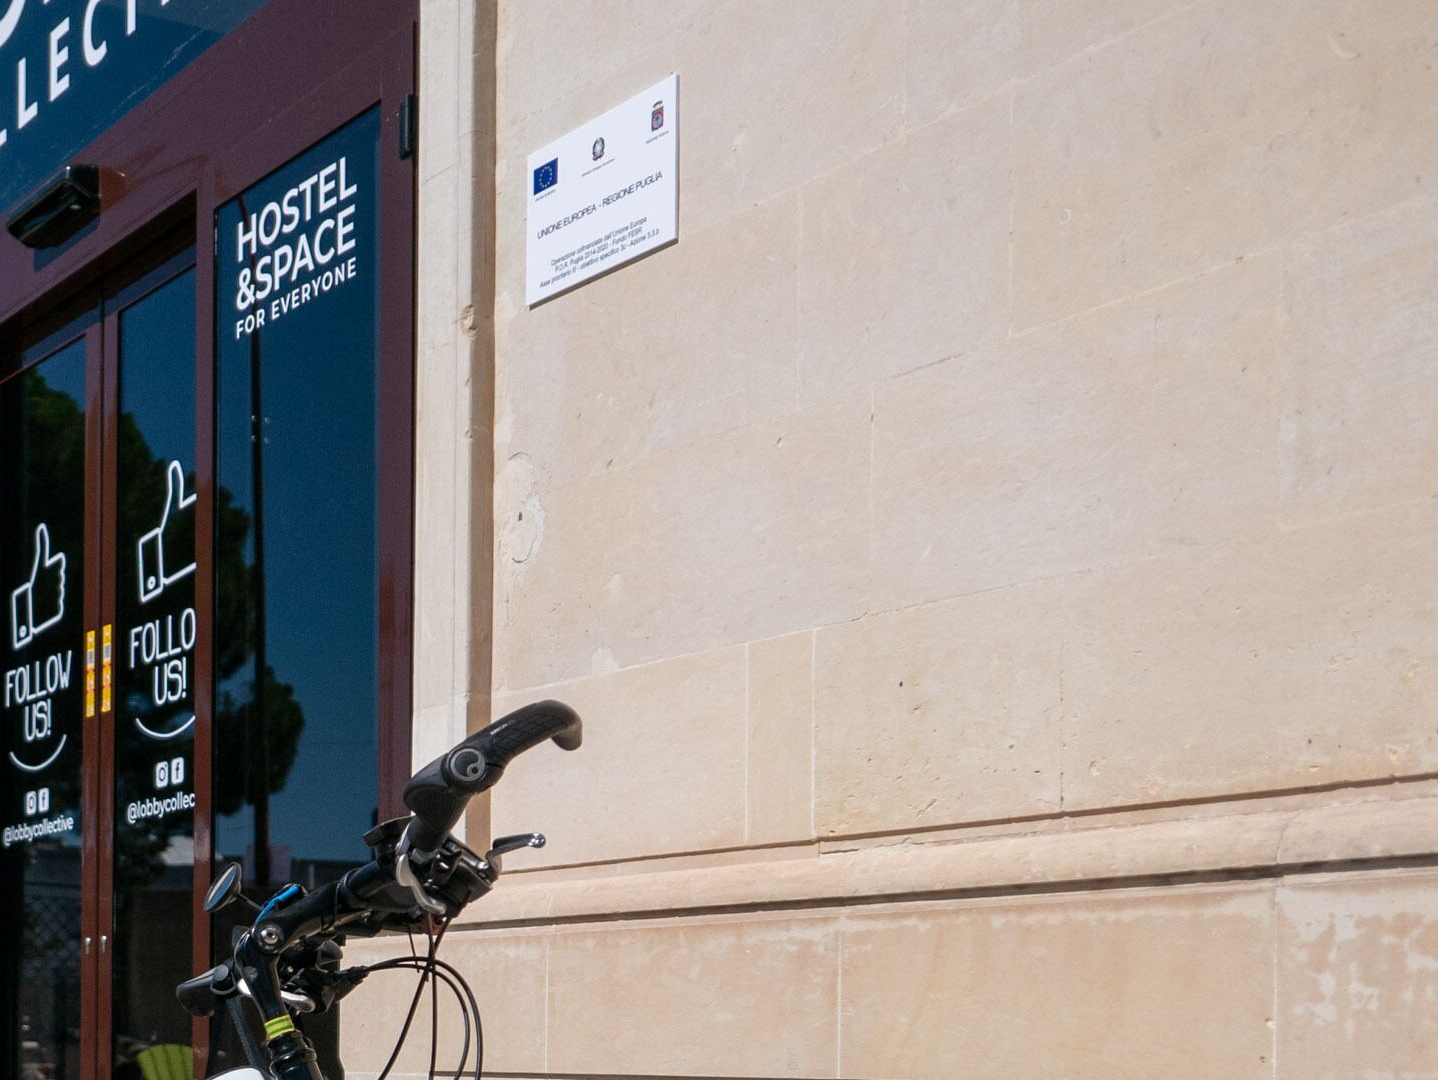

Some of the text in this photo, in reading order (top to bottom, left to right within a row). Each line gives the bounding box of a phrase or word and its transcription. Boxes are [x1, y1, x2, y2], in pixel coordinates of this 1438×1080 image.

[237, 156, 358, 263] HOSTEL
[537, 219, 563, 240] UNIONE
[563, 204, 596, 227] EUROPEA
[602, 184, 634, 207] REGIONE
[635, 171, 663, 193] PUGLIA
[236, 204, 357, 310] &SPACE
[235, 256, 357, 340] FOR EVERYONE
[4, 650, 73, 709] FOLLOW
[153, 656, 188, 706] US!
[23, 698, 52, 742] US!
[2, 814, 75, 847] @lobbycollective
